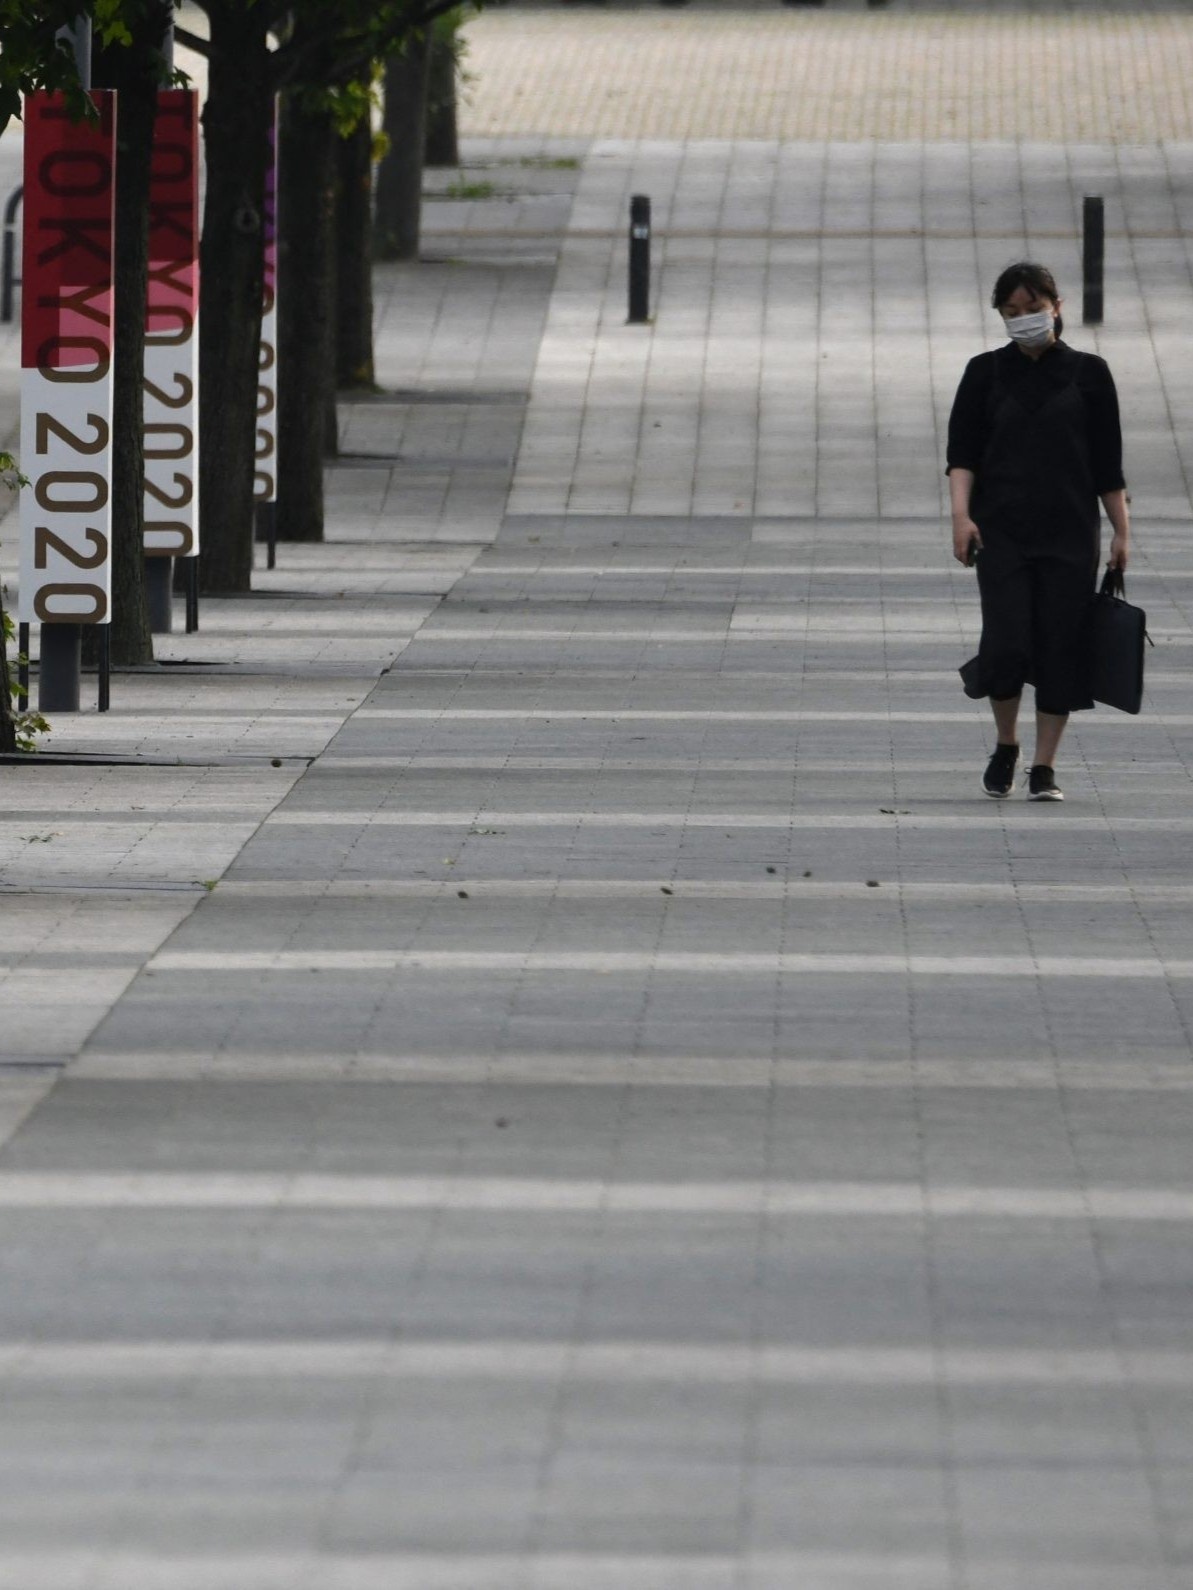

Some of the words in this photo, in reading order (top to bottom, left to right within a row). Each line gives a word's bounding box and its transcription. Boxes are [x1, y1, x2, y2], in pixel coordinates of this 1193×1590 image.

[36, 89, 111, 383] TOKYO
[33, 412, 109, 623] 2020
[143, 372, 193, 556] 2020
